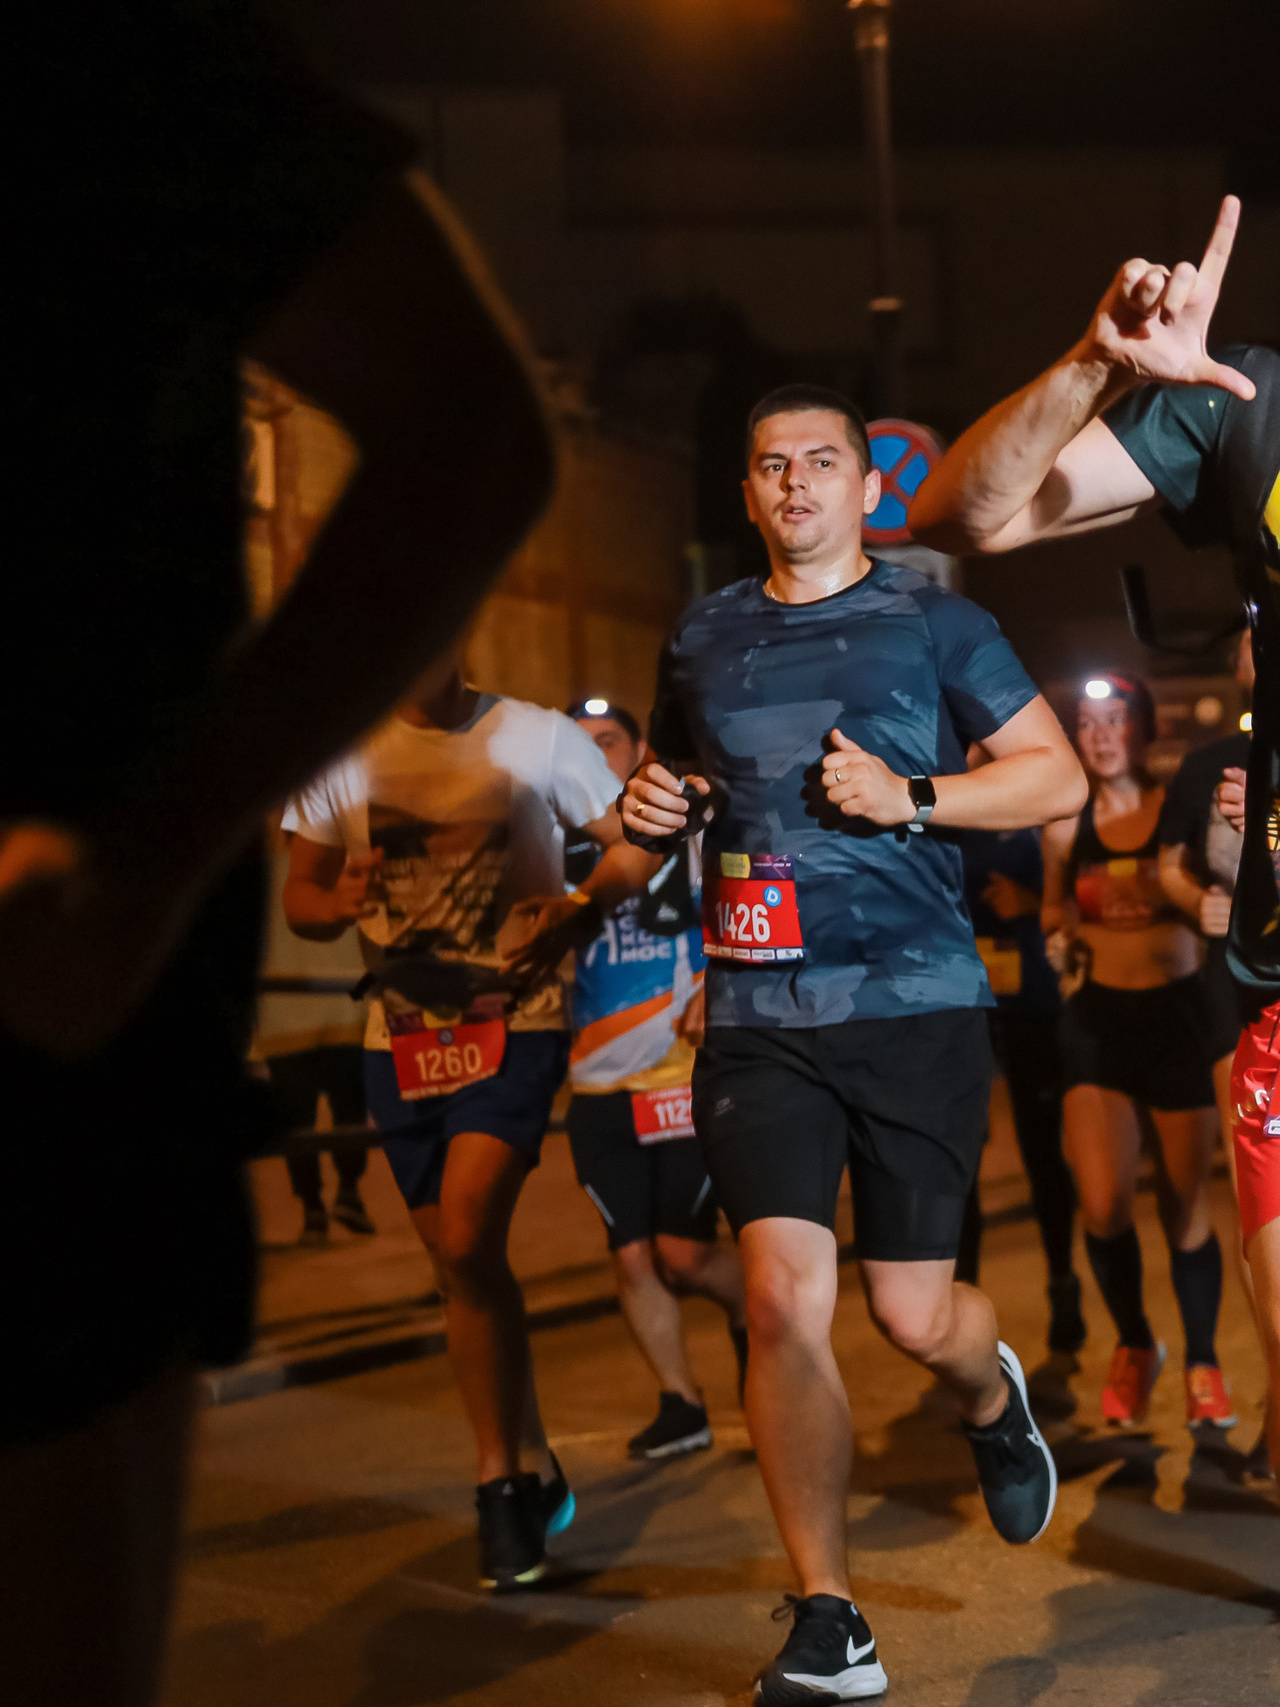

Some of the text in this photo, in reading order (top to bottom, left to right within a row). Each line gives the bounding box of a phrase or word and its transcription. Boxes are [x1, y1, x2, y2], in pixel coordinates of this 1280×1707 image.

[715, 901, 771, 943] 1426
[415, 1042, 482, 1082] 1260
[654, 1098, 692, 1128] 112
